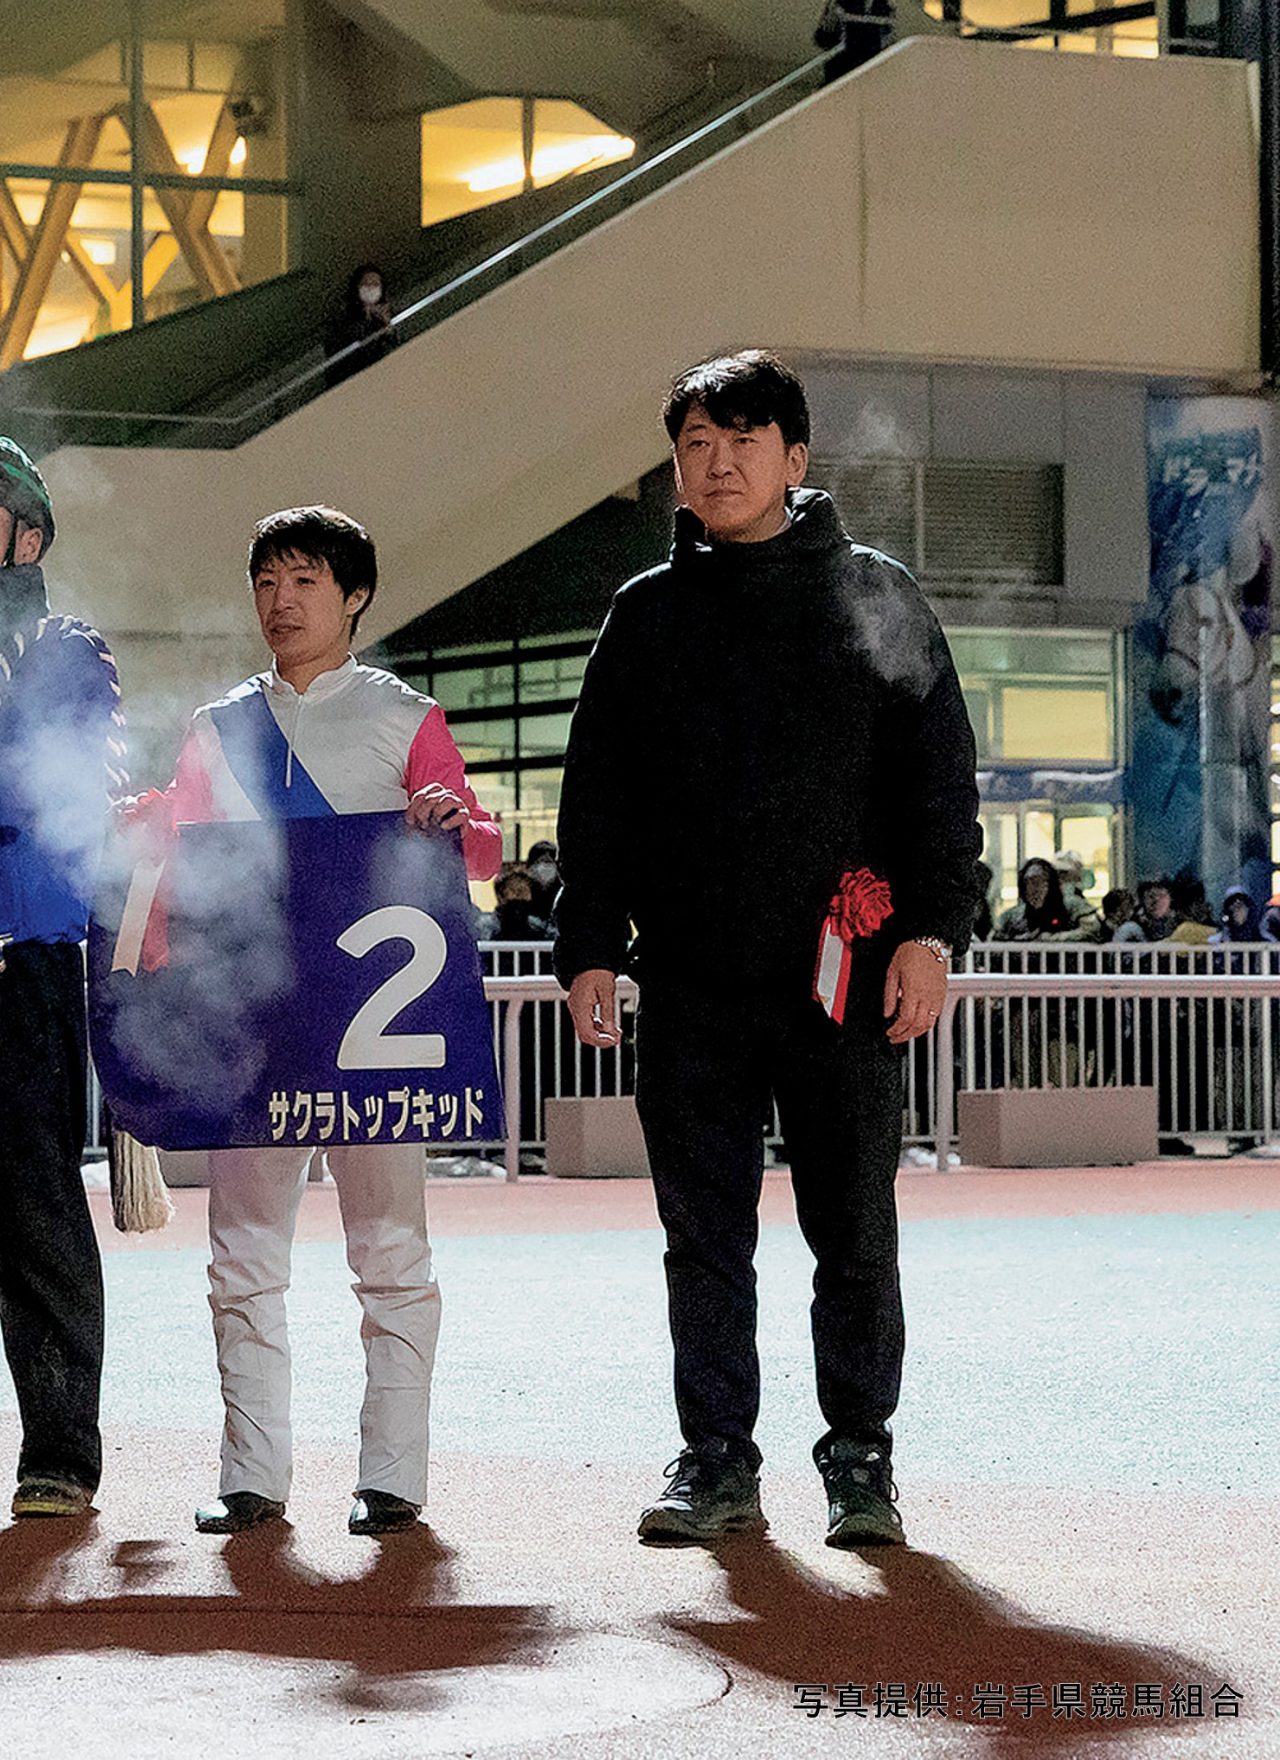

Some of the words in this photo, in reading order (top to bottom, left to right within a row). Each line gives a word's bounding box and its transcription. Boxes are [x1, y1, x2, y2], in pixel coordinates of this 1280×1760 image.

[336, 905, 448, 1070] 2
[268, 1087, 484, 1141] サクラトップキッド
